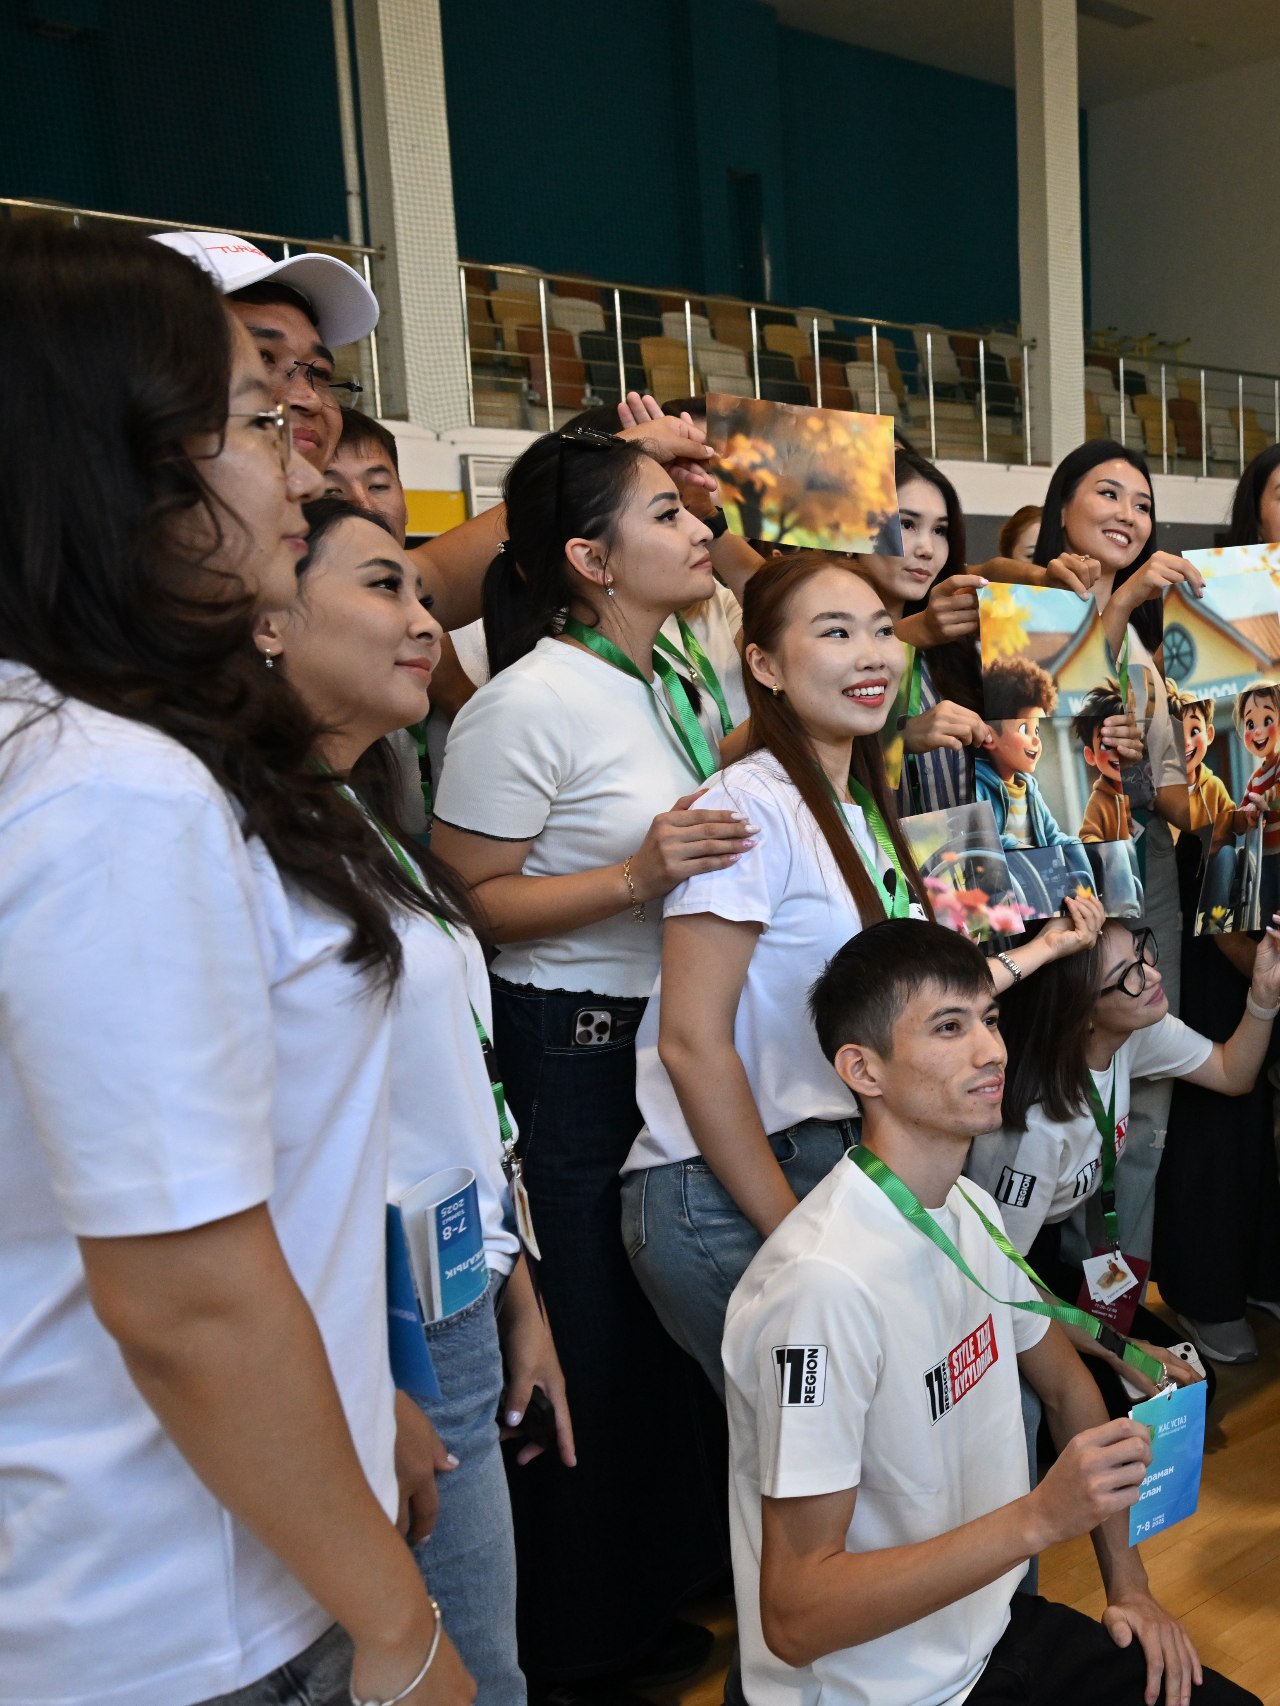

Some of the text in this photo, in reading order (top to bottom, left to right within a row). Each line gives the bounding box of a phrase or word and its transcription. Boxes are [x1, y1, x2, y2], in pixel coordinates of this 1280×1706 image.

[998, 1167, 1024, 1205] 11
[1016, 1175, 1032, 1207] REGION
[441, 1198, 464, 1218] 2025
[442, 1217, 467, 1240] 7-8
[952, 1336, 976, 1377] STYLE
[776, 1348, 805, 1405] 11
[804, 1348, 819, 1404] REGION
[925, 1365, 945, 1422] 11
[941, 1361, 950, 1411] REGION
[1140, 1465, 1175, 1487] араман
[1136, 1520, 1150, 1536] 7-8
